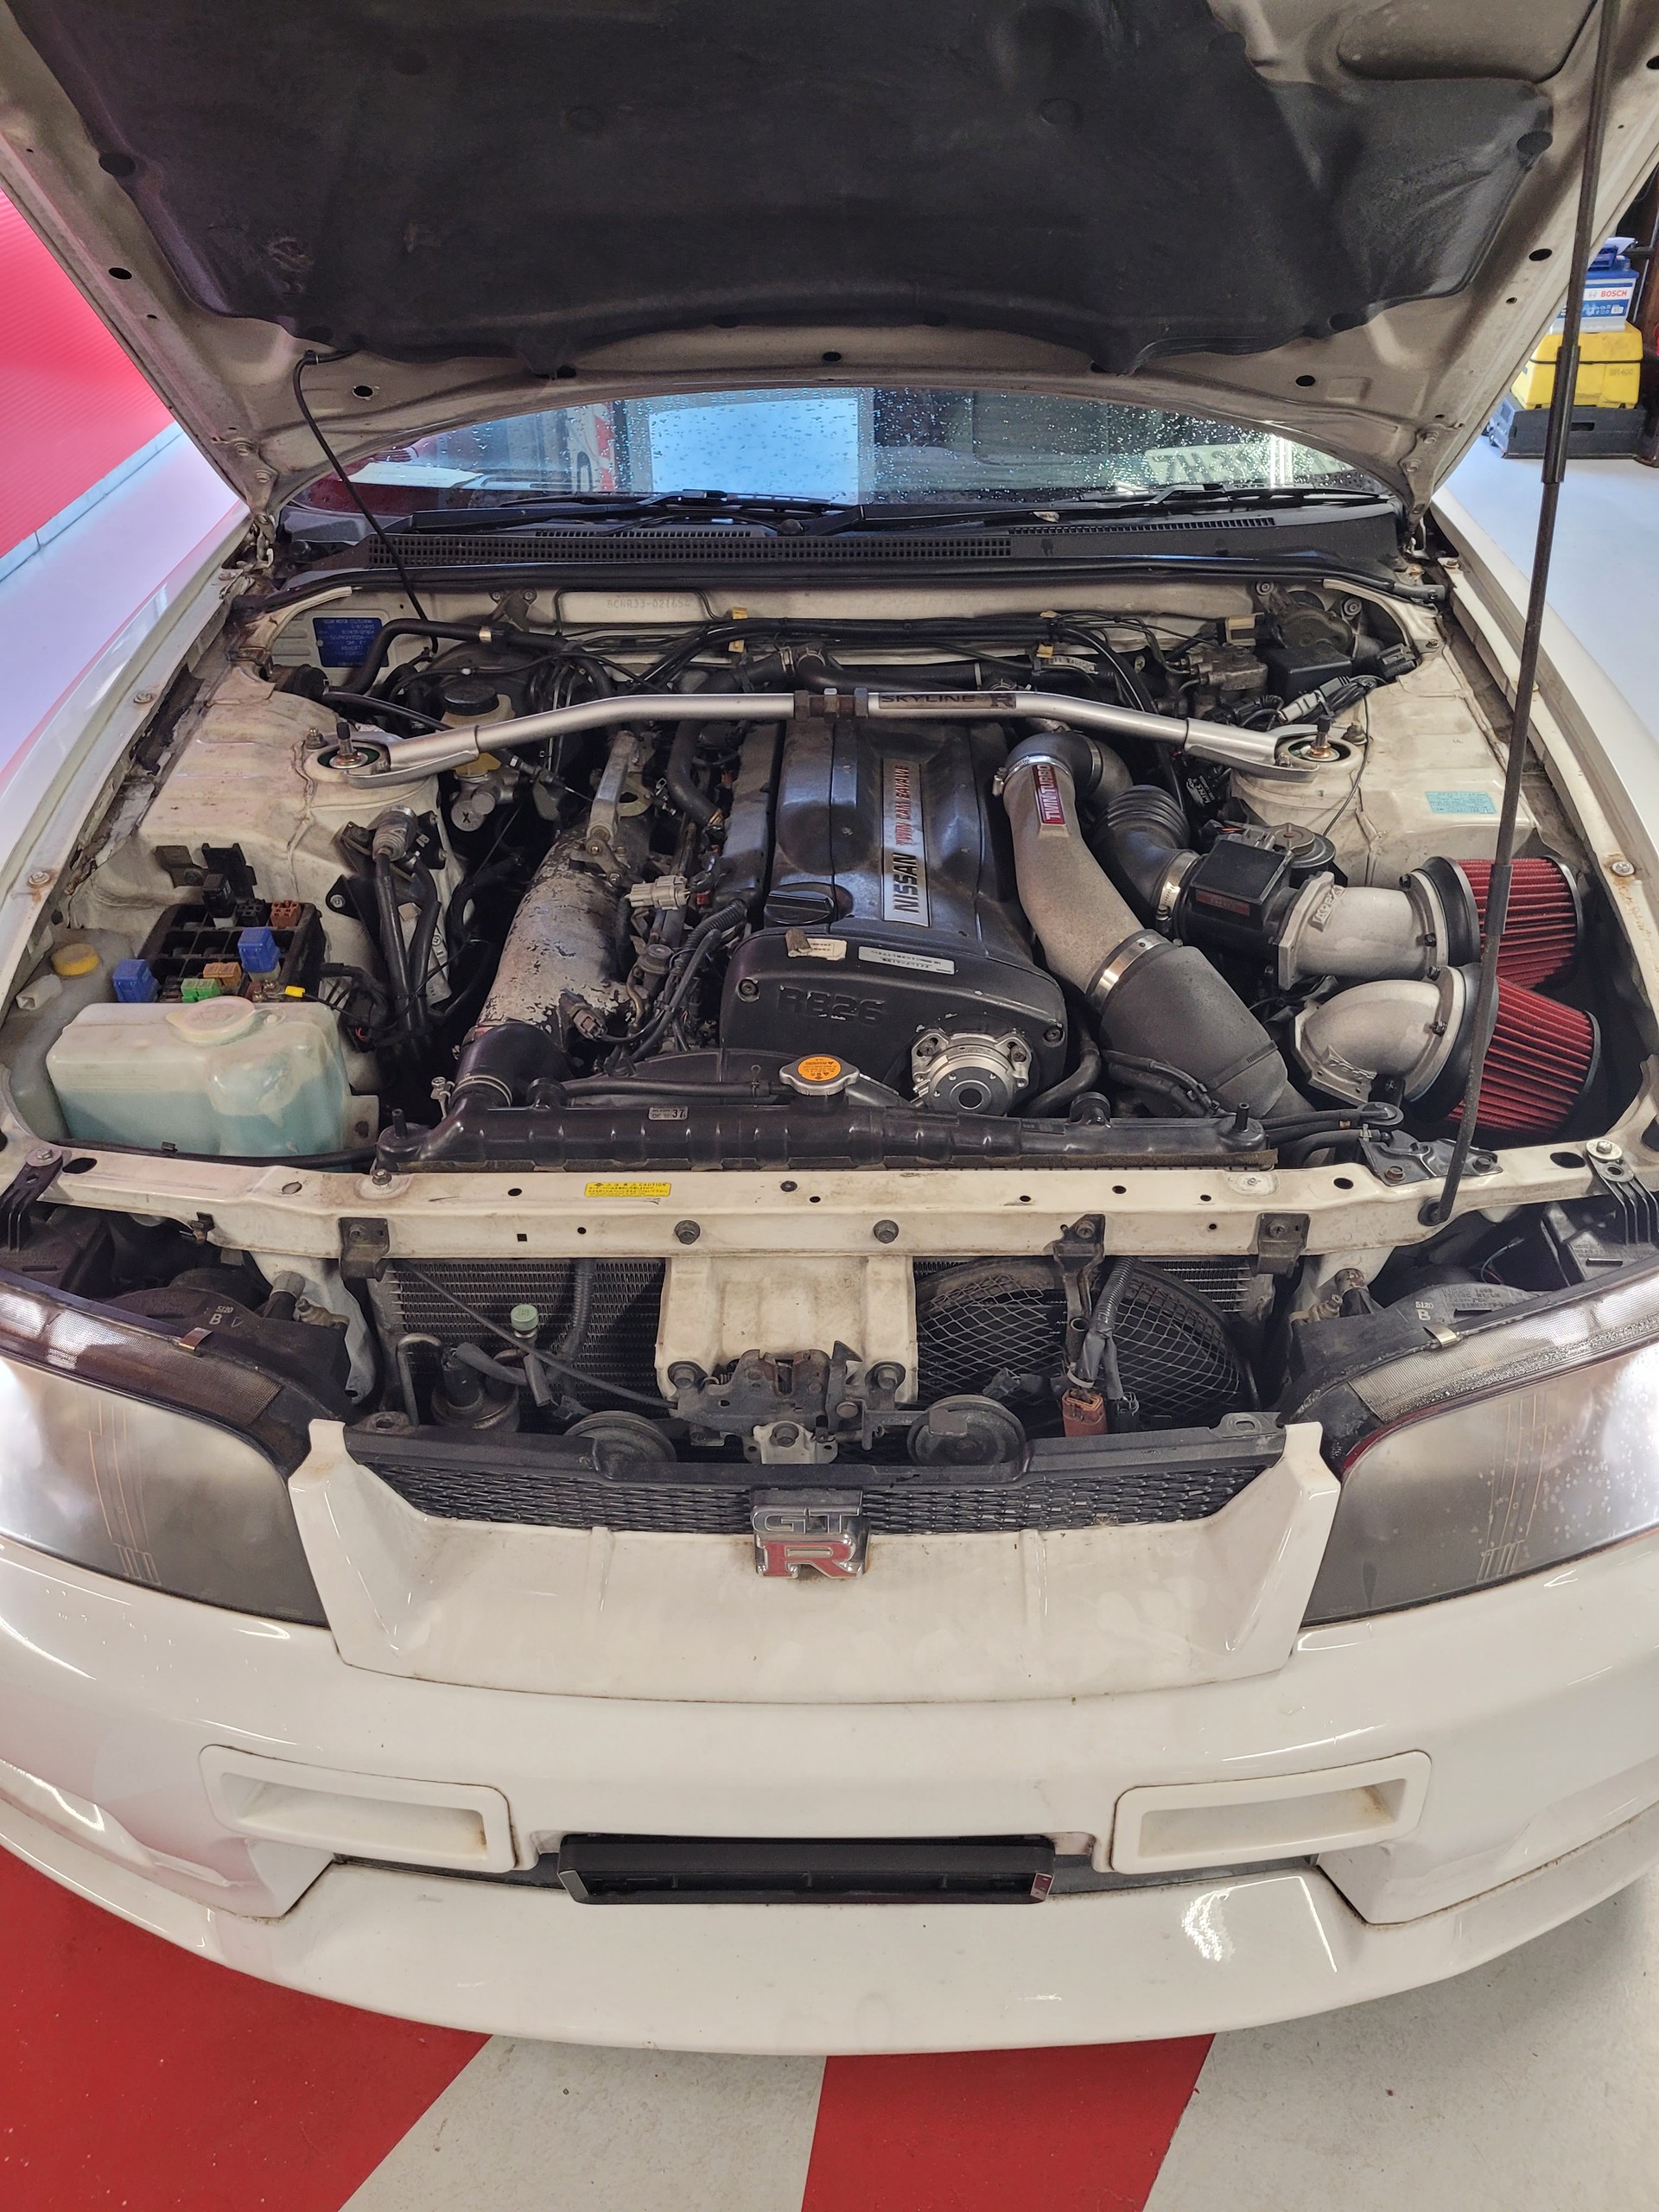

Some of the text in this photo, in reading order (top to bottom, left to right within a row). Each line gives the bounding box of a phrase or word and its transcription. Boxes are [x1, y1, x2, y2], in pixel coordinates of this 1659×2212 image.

[880, 694, 976, 703] SKYLINE
[1037, 764, 1062, 820] TWIN TURBO
[893, 852, 920, 915] NISSAN
[779, 985, 887, 1028] RB26
[671, 1109, 685, 1118] 37
[208, 1313, 223, 1325] B
[1417, 1309, 1431, 1321] B
[752, 1507, 861, 1535] GT
[757, 1540, 861, 1580] R
